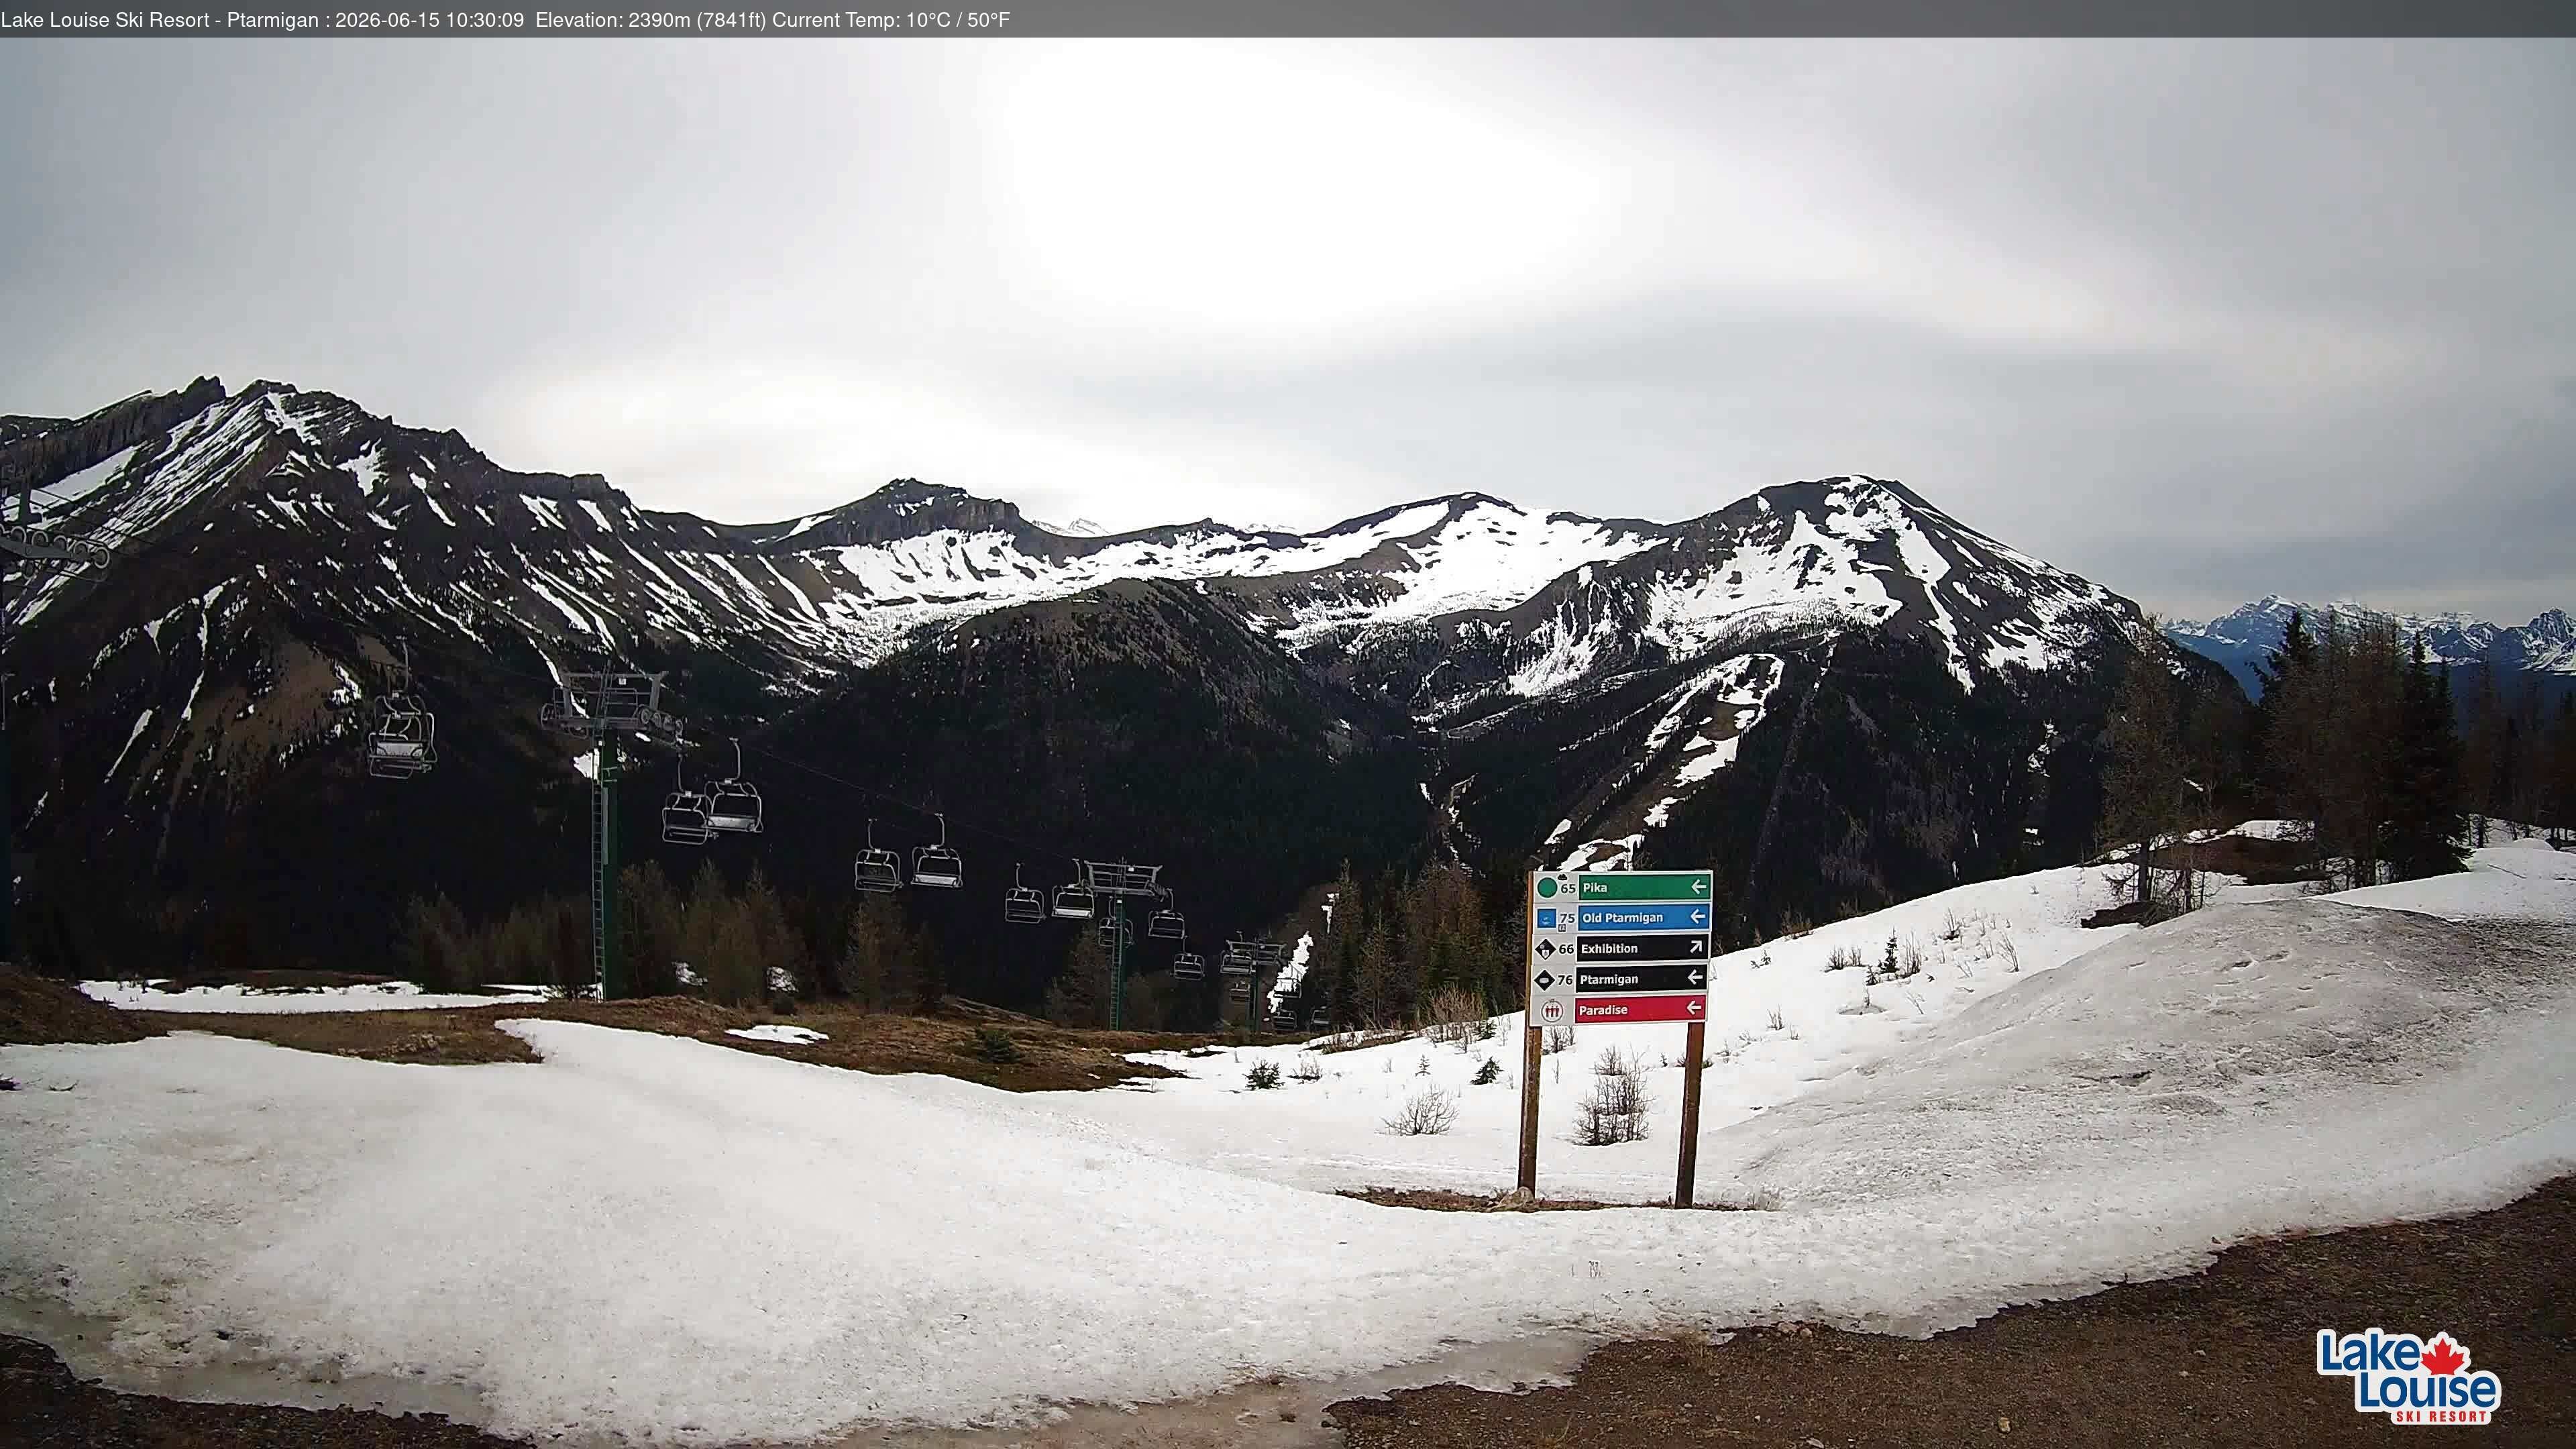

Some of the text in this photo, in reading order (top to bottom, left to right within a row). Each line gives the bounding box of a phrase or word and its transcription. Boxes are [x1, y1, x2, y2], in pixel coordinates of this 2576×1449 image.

[1560, 882, 1608, 894] 65 Pika
[1560, 912, 1664, 924] 75 Old Ptarmigan
[1558, 943, 1638, 954] 66 Exhibition
[1558, 975, 1639, 987] 76 Ptarmigan
[1579, 1005, 1628, 1016] Paradise
